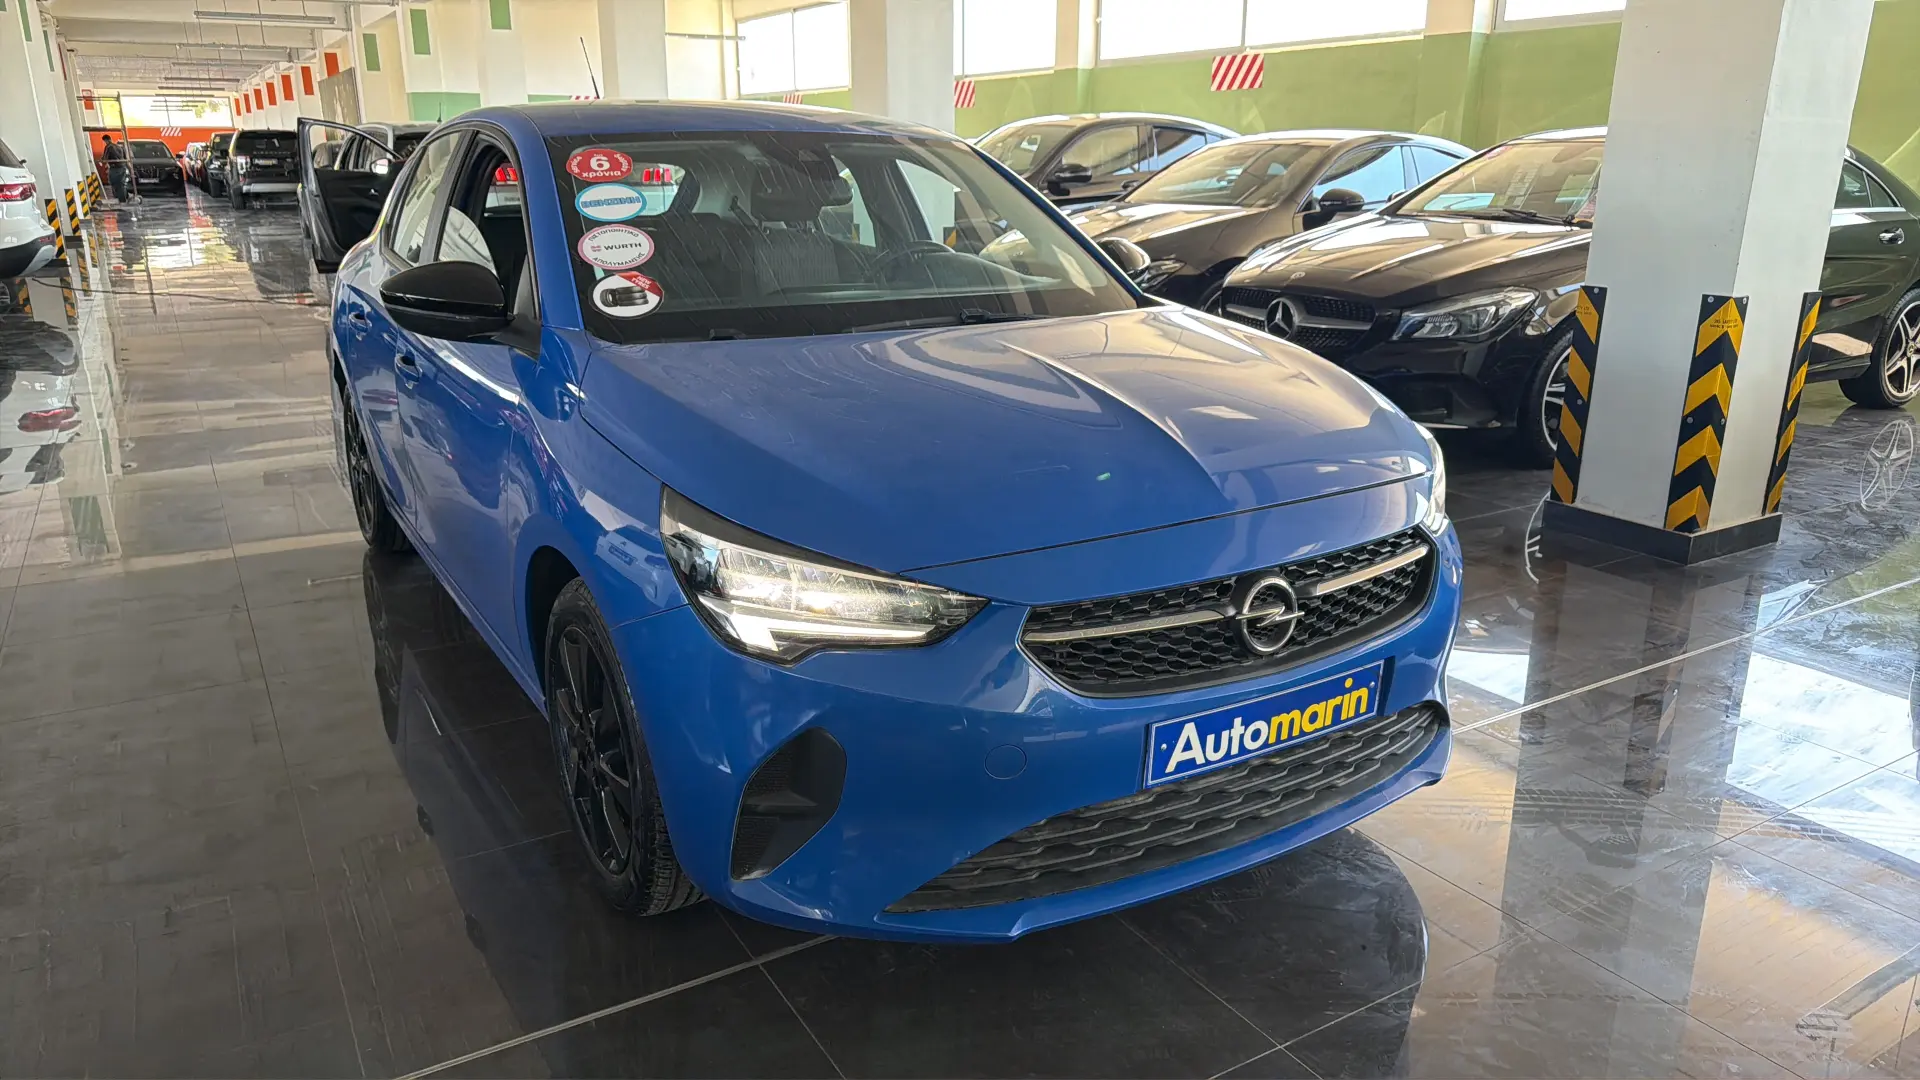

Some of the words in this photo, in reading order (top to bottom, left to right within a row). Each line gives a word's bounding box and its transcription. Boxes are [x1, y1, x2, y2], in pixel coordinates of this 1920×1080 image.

[590, 156, 610, 171] 6
[582, 170, 621, 179] χρόνια
[1164, 677, 1369, 774] Automarin
